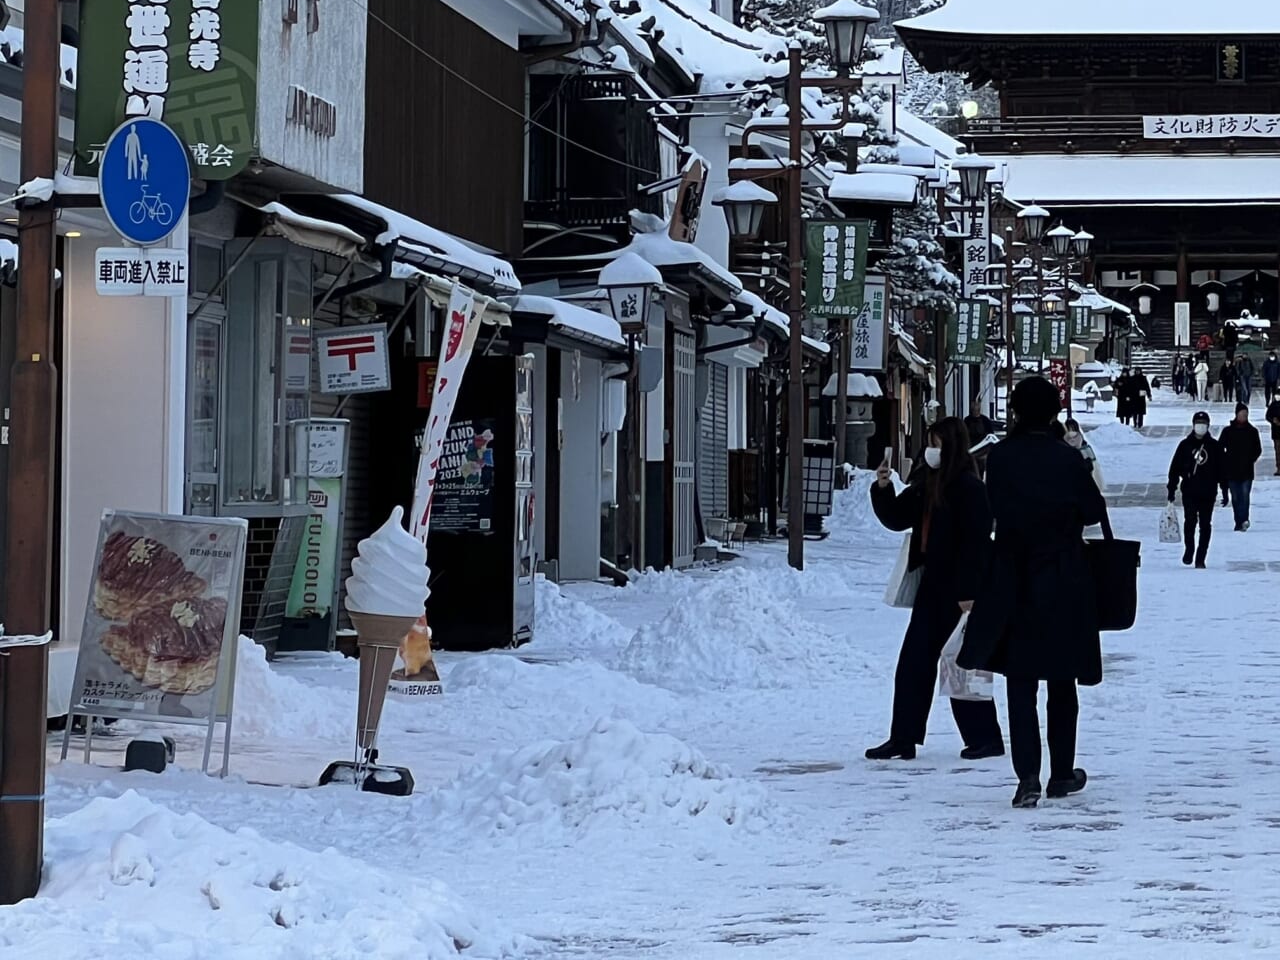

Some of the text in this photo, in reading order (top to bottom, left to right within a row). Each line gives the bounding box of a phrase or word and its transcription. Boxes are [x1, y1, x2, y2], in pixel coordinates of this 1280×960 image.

[98, 259, 185, 285] 車両進入禁止
[439, 469, 462, 481] 2023
[190, 548, 232, 558] BENI-BENI
